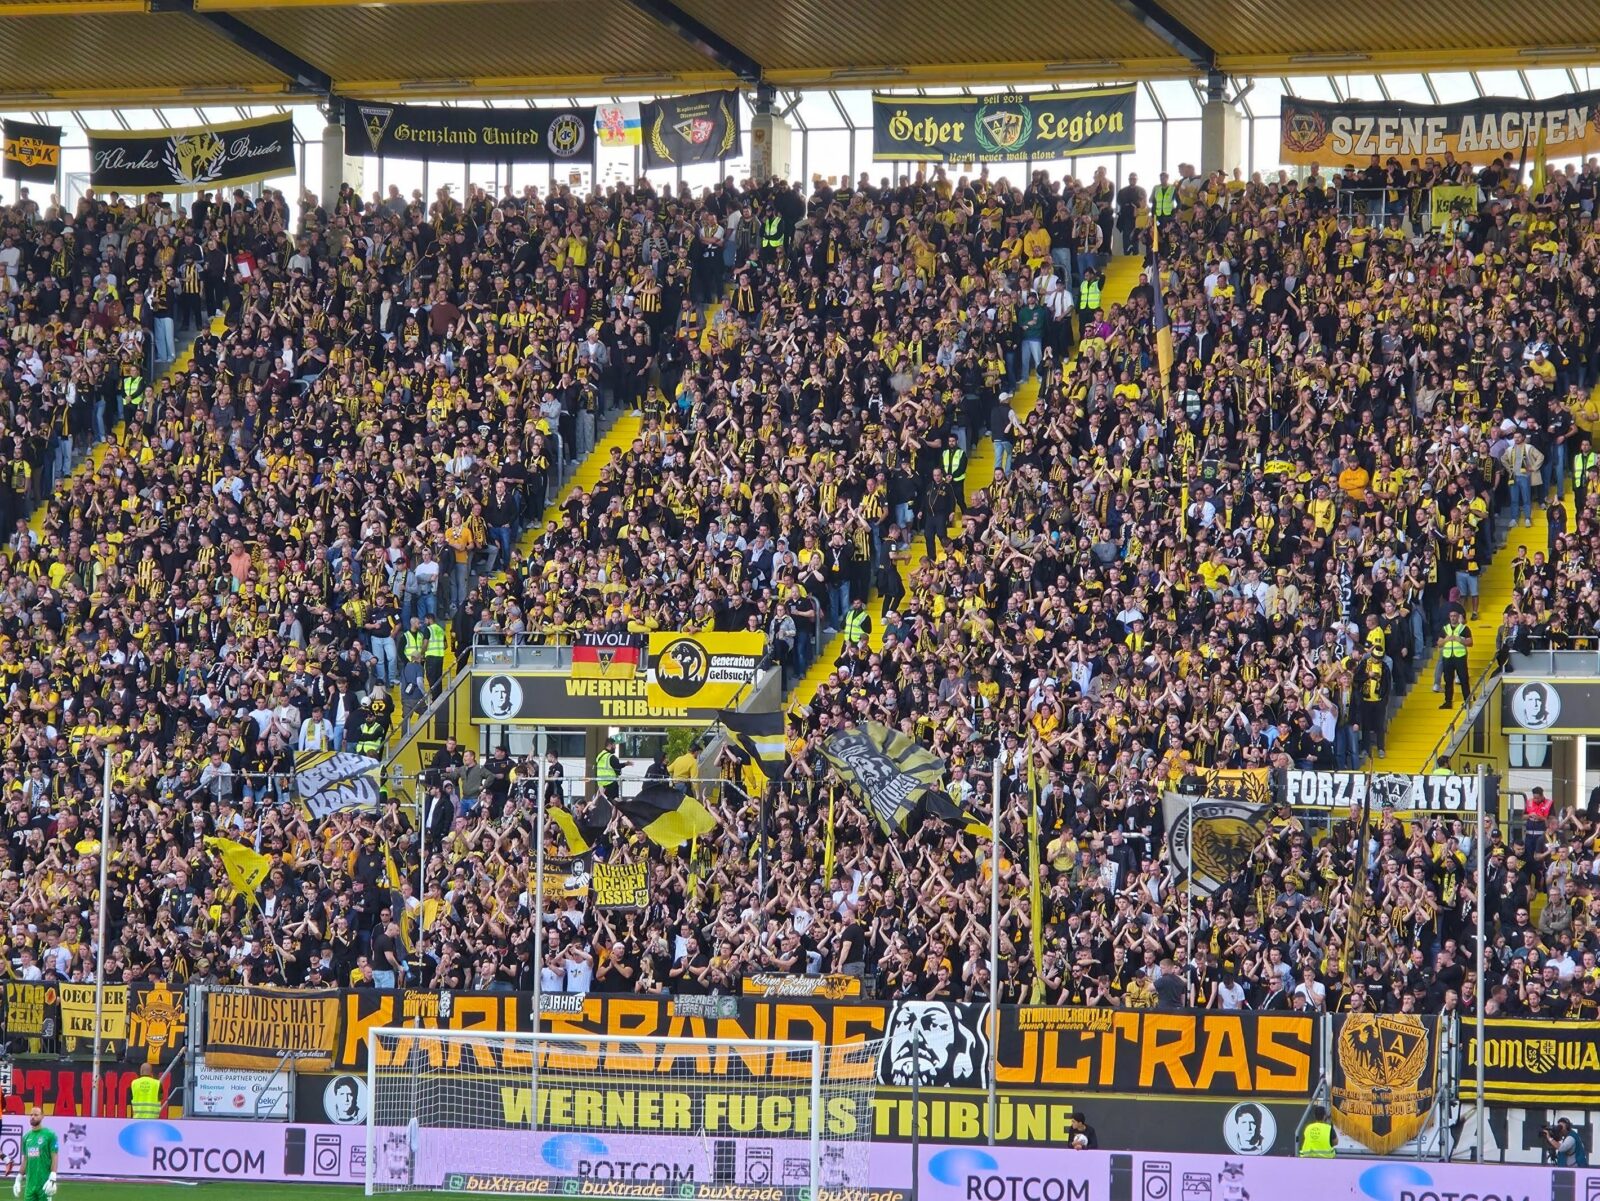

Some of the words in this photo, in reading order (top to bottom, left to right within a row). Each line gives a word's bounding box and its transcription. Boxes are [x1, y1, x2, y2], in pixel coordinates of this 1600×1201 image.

[1003, 95, 1023, 104] 2012
[394, 123, 477, 146] Grenzland
[482, 126, 538, 145] United
[889, 110, 965, 147] Öcher
[1037, 110, 1124, 142] Legion
[1331, 115, 1448, 156] SZENE
[1458, 105, 1589, 153] AACHEN
[979, 153, 1003, 162] never
[583, 633, 631, 646] TIVOLI
[711, 655, 755, 667] Generation
[565, 679, 648, 697] WERNER
[1287, 770, 1368, 806] FORZA
[1411, 775, 1480, 811] ATSV
[593, 874, 646, 891] OECHER
[596, 890, 635, 905] ASSIS
[7, 983, 45, 1004] PYRO
[62, 989, 124, 1005] OECER
[549, 994, 584, 1011] JAHRE
[214, 993, 326, 1024] FREUNDSCHAFT
[70, 1017, 114, 1033] KRU
[211, 1019, 326, 1050] ZUSAMMENHALT
[1381, 1021, 1422, 1037] ALEMANNIA
[343, 993, 885, 1079] KARLSBANDE
[985, 1007, 1313, 1092] ULTRAS
[501, 1087, 691, 1130] WERNER
[704, 1093, 857, 1134] FUCHS
[870, 1097, 1074, 1142] TRIBÜNE
[152, 1146, 265, 1174] ROTCOM
[578, 1160, 695, 1182] ROTCOM
[466, 1175, 549, 1193] buXtrade
[581, 1179, 665, 1197] buXtrade
[698, 1184, 784, 1201] buXtrade
[818, 1188, 904, 1201] buXtrade
[967, 1175, 1090, 1201] ROTCOM
